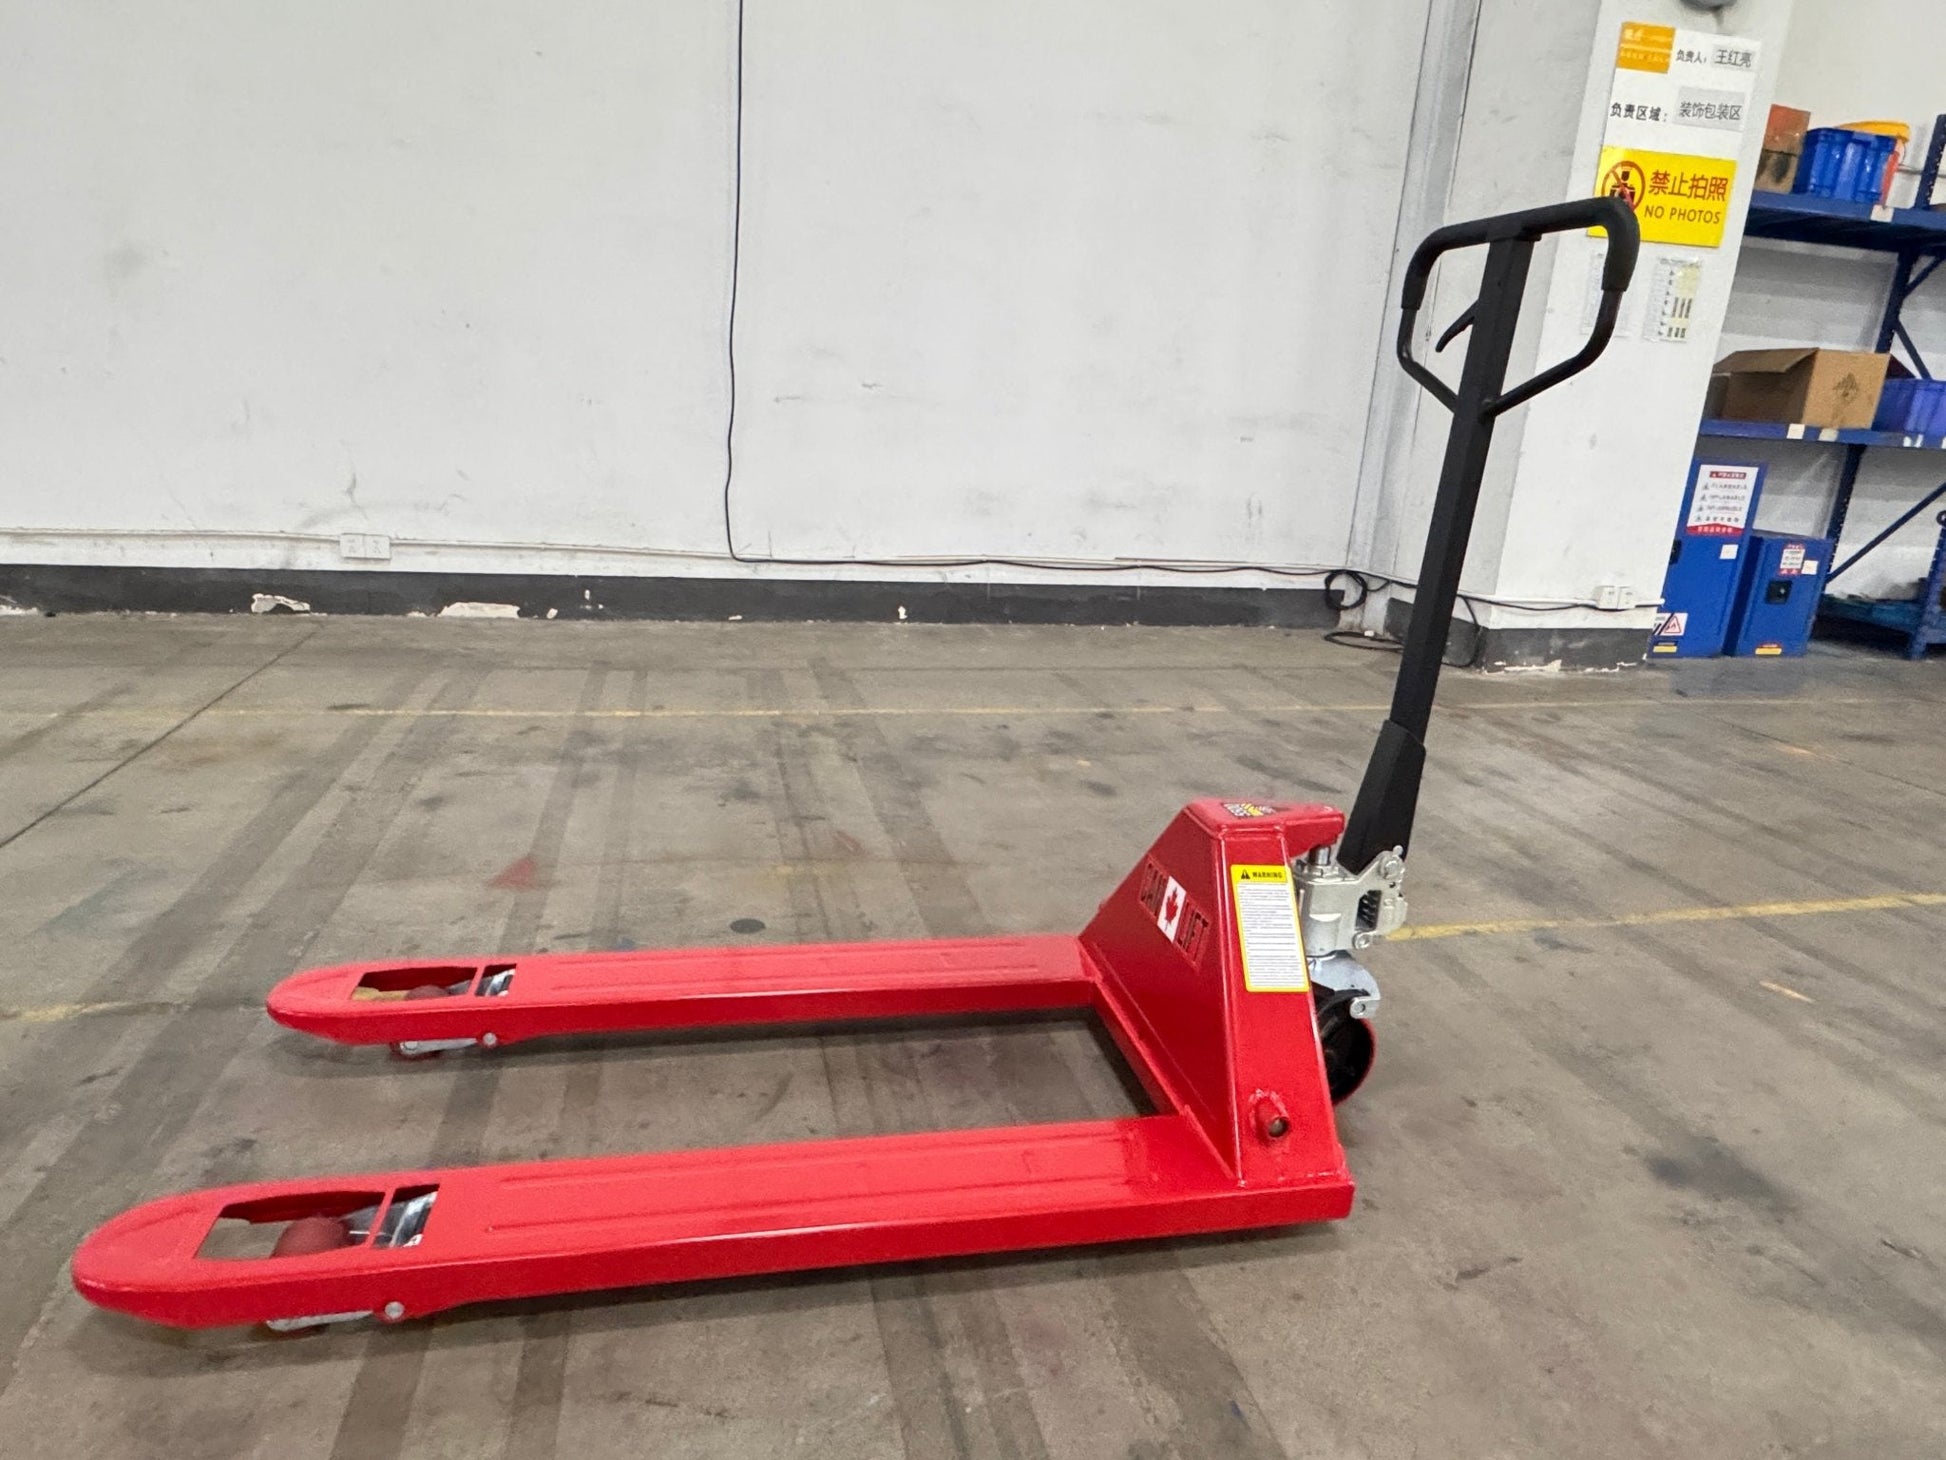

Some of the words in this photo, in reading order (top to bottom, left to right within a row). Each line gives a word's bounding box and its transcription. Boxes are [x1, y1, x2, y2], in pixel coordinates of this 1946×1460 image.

[1714, 49, 1753, 68] 王红亮
[1678, 101, 1743, 121] 装饰包装区
[1648, 169, 1729, 202] 禁止拍照
[1644, 205, 1664, 219] NO
[1669, 207, 1721, 224] PHOTOS
[1252, 871, 1283, 879] WARNING
[1175, 900, 1210, 963] LIFT
